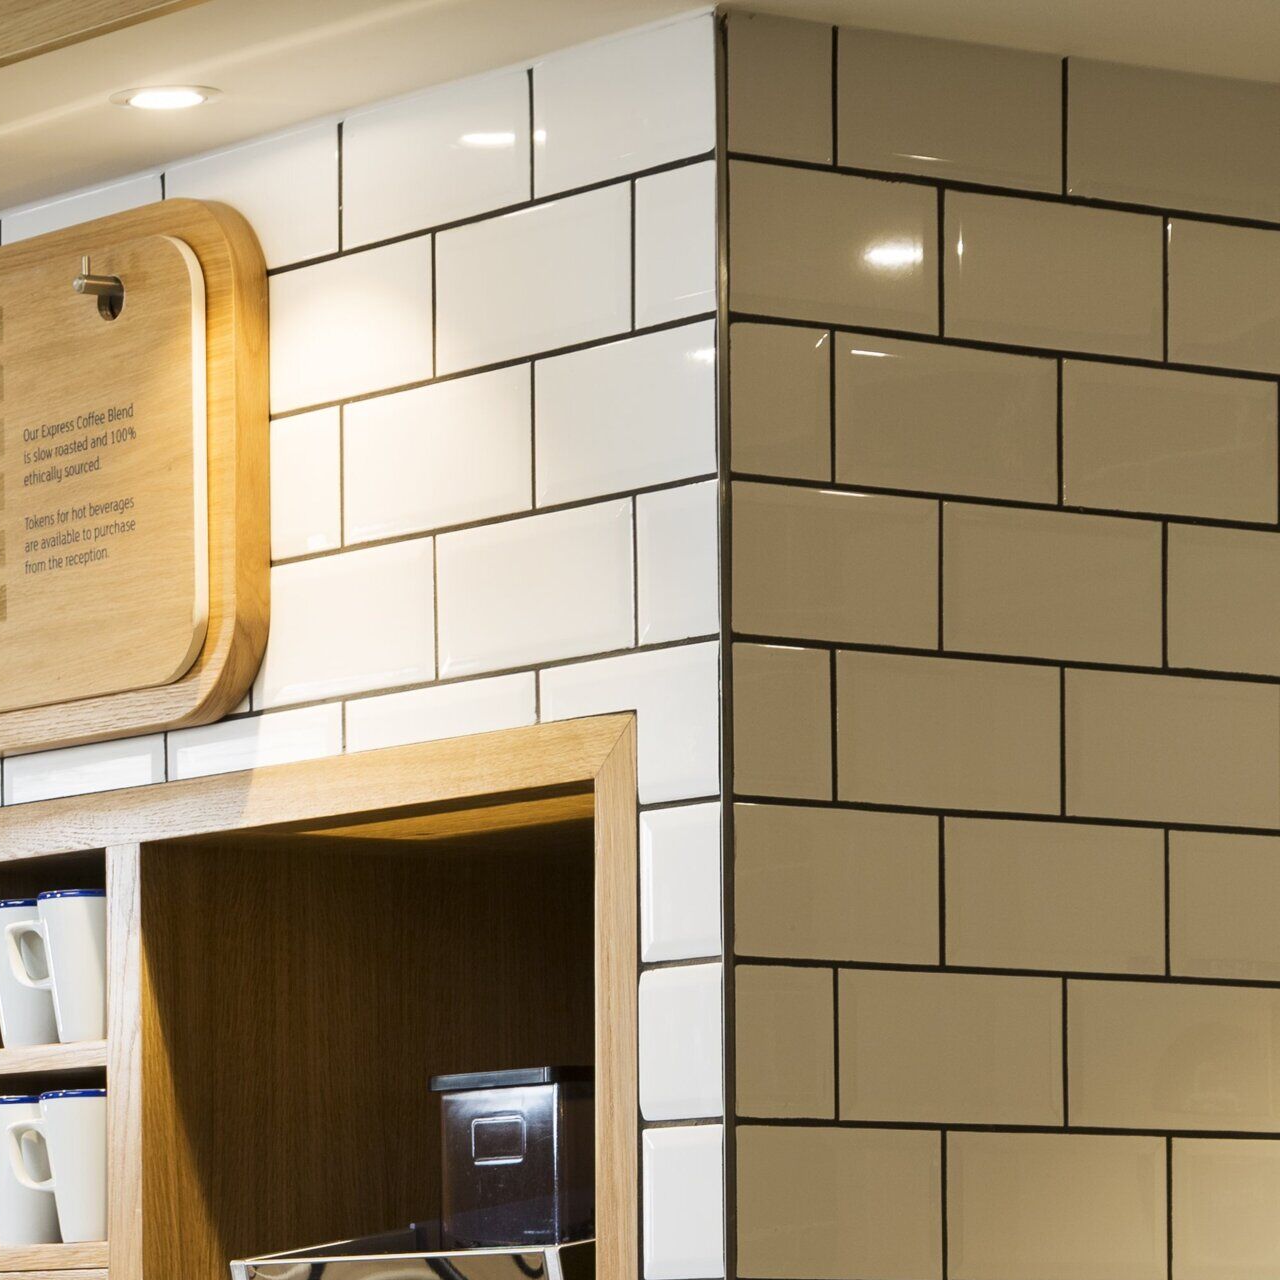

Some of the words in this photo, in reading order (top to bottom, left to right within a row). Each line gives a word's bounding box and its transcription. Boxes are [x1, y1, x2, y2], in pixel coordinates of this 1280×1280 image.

[23, 428, 39, 442] Our
[42, 419, 74, 440] Express
[76, 411, 106, 430] Coffee
[108, 404, 134, 423] Blend
[24, 452, 31, 464] is
[33, 446, 52, 462] slow
[55, 438, 88, 458] roasted
[90, 434, 108, 449] and
[111, 426, 137, 444] 100%
[24, 468, 62, 487] ethically
[25, 513, 54, 530] Tokens
[56, 510, 69, 524] for
[71, 506, 86, 520] hot
[89, 497, 134, 516] beverages
[24, 540, 38, 553] are
[40, 529, 80, 550] available
[83, 528, 91, 541] to
[94, 519, 136, 539] purchase
[25, 560, 46, 574] from
[48, 555, 62, 570] the
